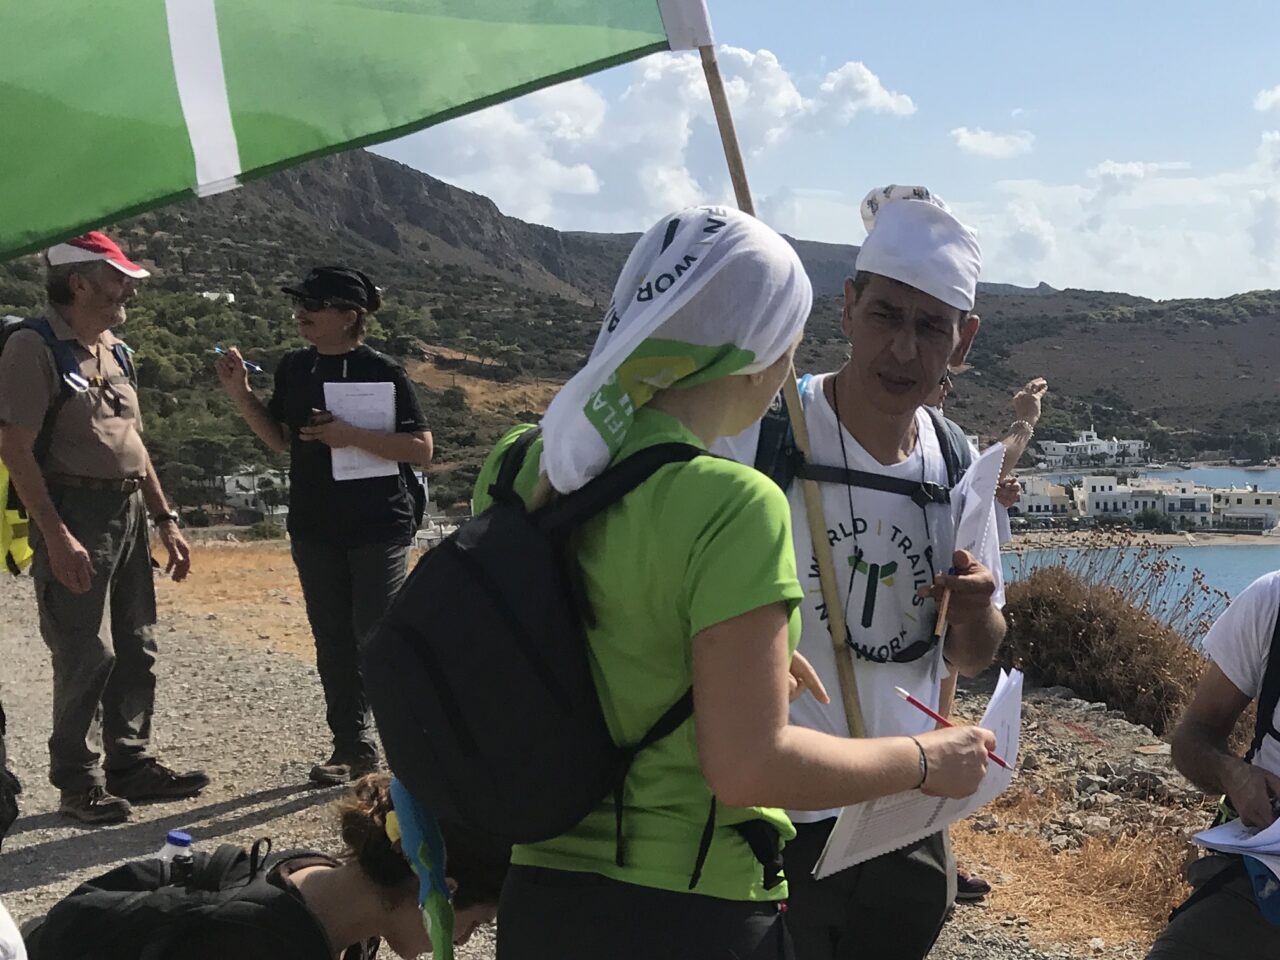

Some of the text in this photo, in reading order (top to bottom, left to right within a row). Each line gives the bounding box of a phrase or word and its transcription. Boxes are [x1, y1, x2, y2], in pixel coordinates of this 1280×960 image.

[636, 254, 698, 303] WOR
[808, 518, 928, 608] WRLD TRAILS
